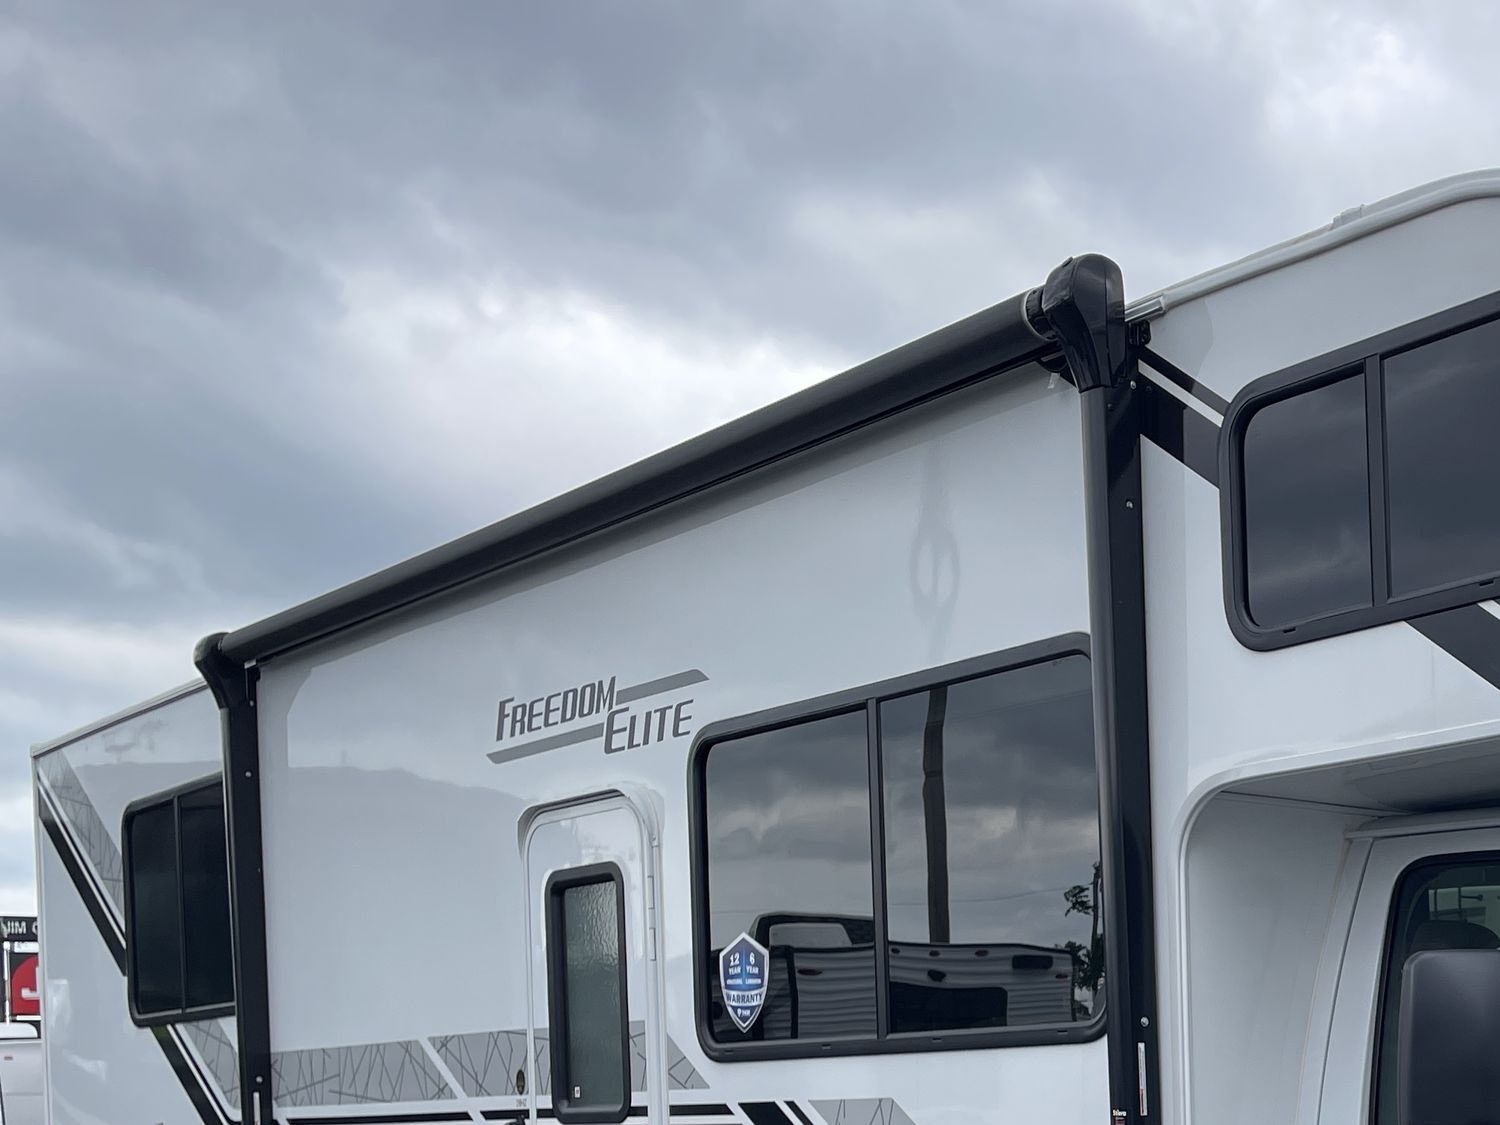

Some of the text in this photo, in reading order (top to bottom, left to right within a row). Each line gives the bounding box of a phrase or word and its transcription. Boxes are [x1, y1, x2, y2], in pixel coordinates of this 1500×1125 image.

[496, 675, 617, 742] FREEDOM
[604, 699, 694, 755] ELITE
[729, 952, 740, 966] 12
[745, 965, 759, 974] YEAR
[725, 991, 762, 1004] WARRANTY
